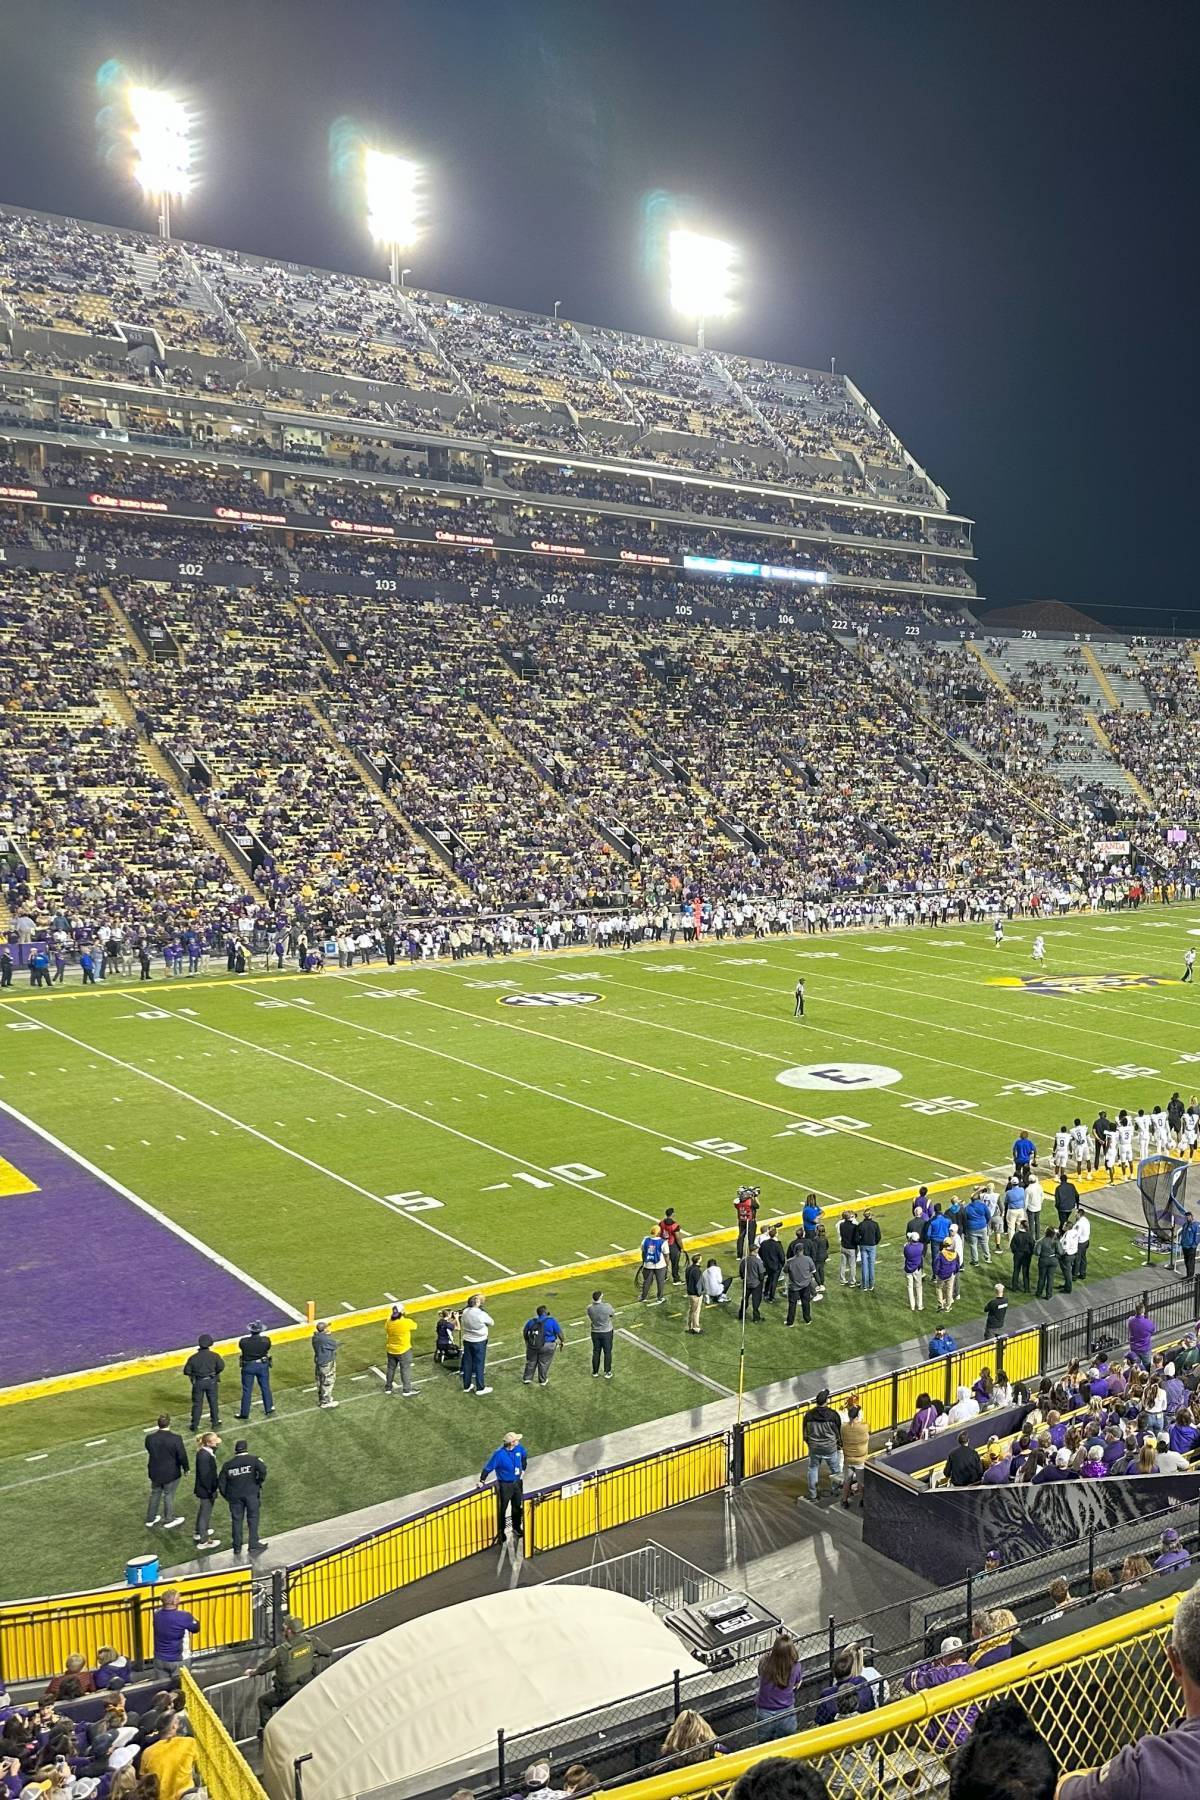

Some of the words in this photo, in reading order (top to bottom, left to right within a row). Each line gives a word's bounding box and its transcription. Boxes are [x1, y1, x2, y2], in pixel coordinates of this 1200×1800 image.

[178, 563, 203, 577] 102
[376, 579, 397, 592] 103
[545, 594, 565, 605] 104
[675, 605, 692, 616] 105
[778, 614, 794, 625] 106
[832, 620, 848, 630] 222
[905, 626, 920, 636] 223
[1021, 630, 1037, 639] 224
[5, 1021, 43, 1032] 5
[1092, 1063, 1162, 1081] 35
[1001, 1078, 1078, 1098] 30
[900, 1096, 982, 1117] 25
[785, 1114, 874, 1138] 20
[660, 1137, 749, 1161] 15
[511, 1162, 608, 1189] 10
[383, 1190, 446, 1213] 5
[228, 1465, 252, 1477] POLICE
[717, 1613, 754, 1630] LSU
